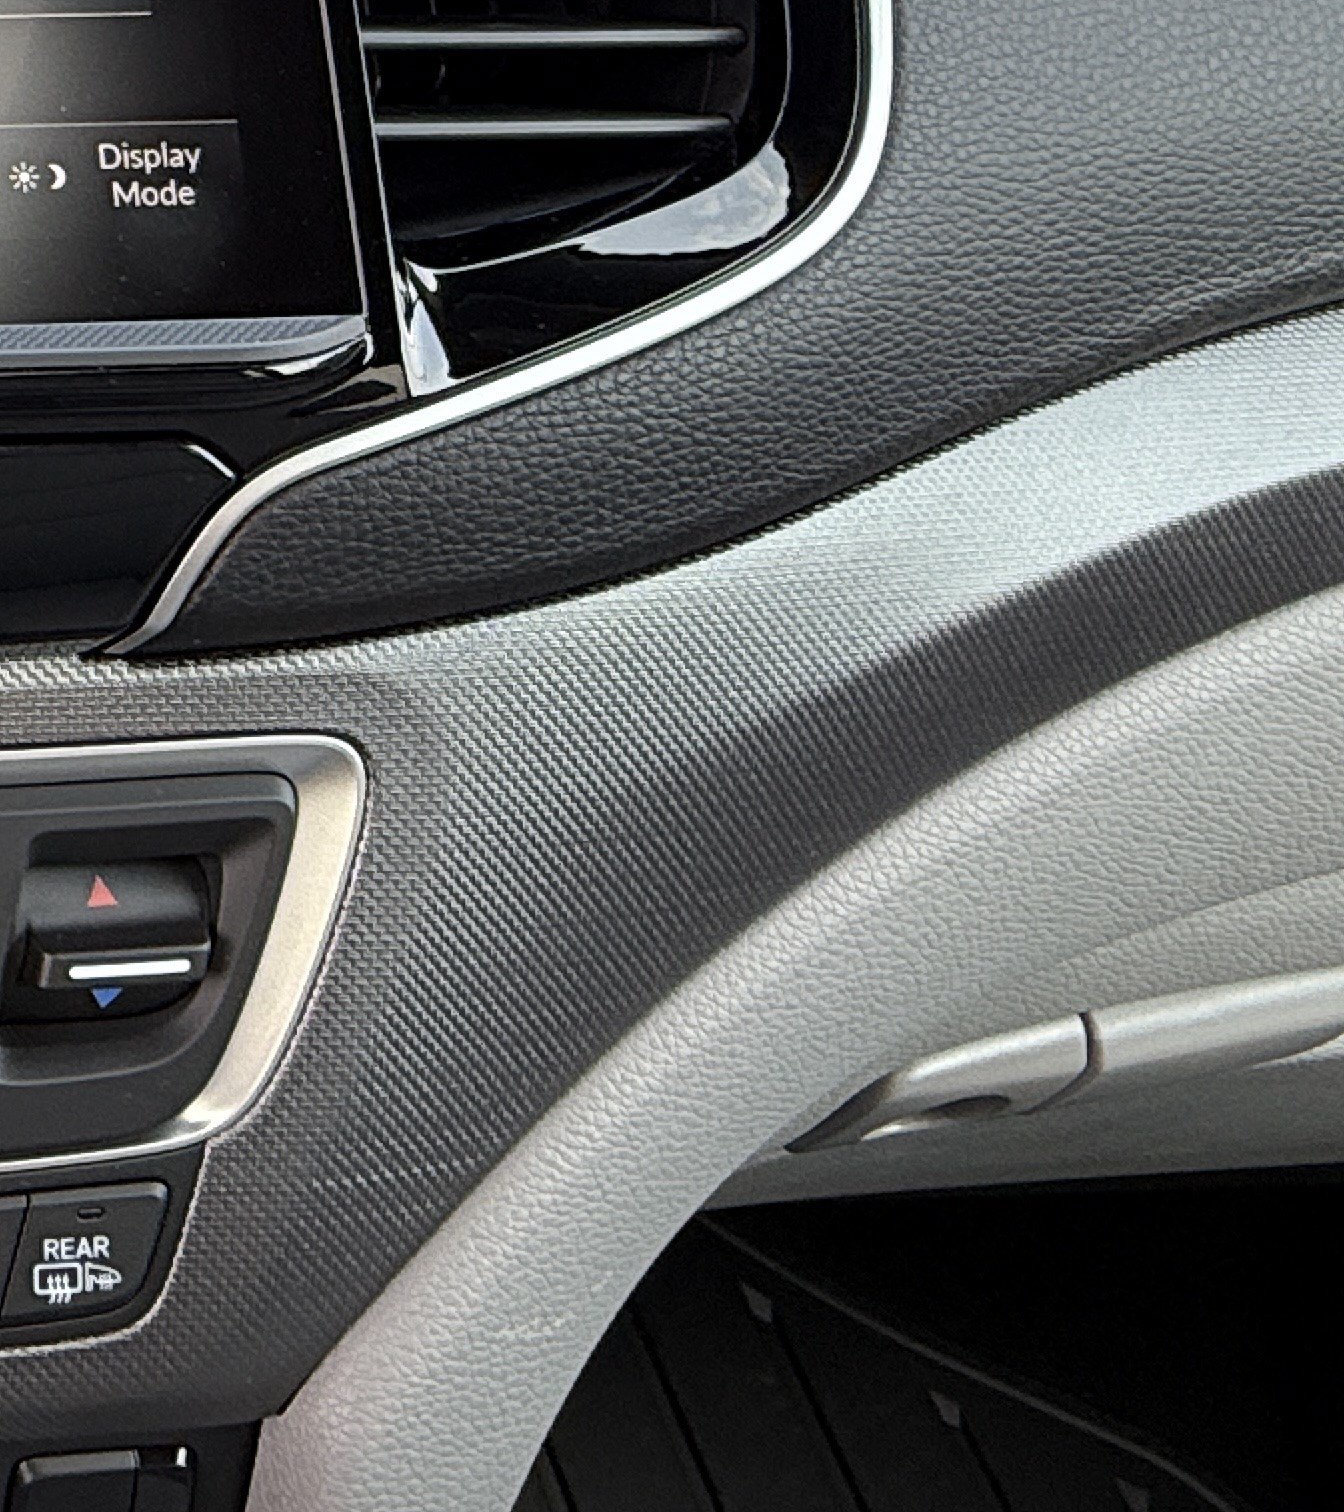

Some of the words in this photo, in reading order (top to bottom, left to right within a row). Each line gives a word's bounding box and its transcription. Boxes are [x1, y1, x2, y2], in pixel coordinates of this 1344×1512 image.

[98, 141, 201, 174] Display
[113, 179, 195, 207] Mode
[43, 1235, 109, 1261] REAR
